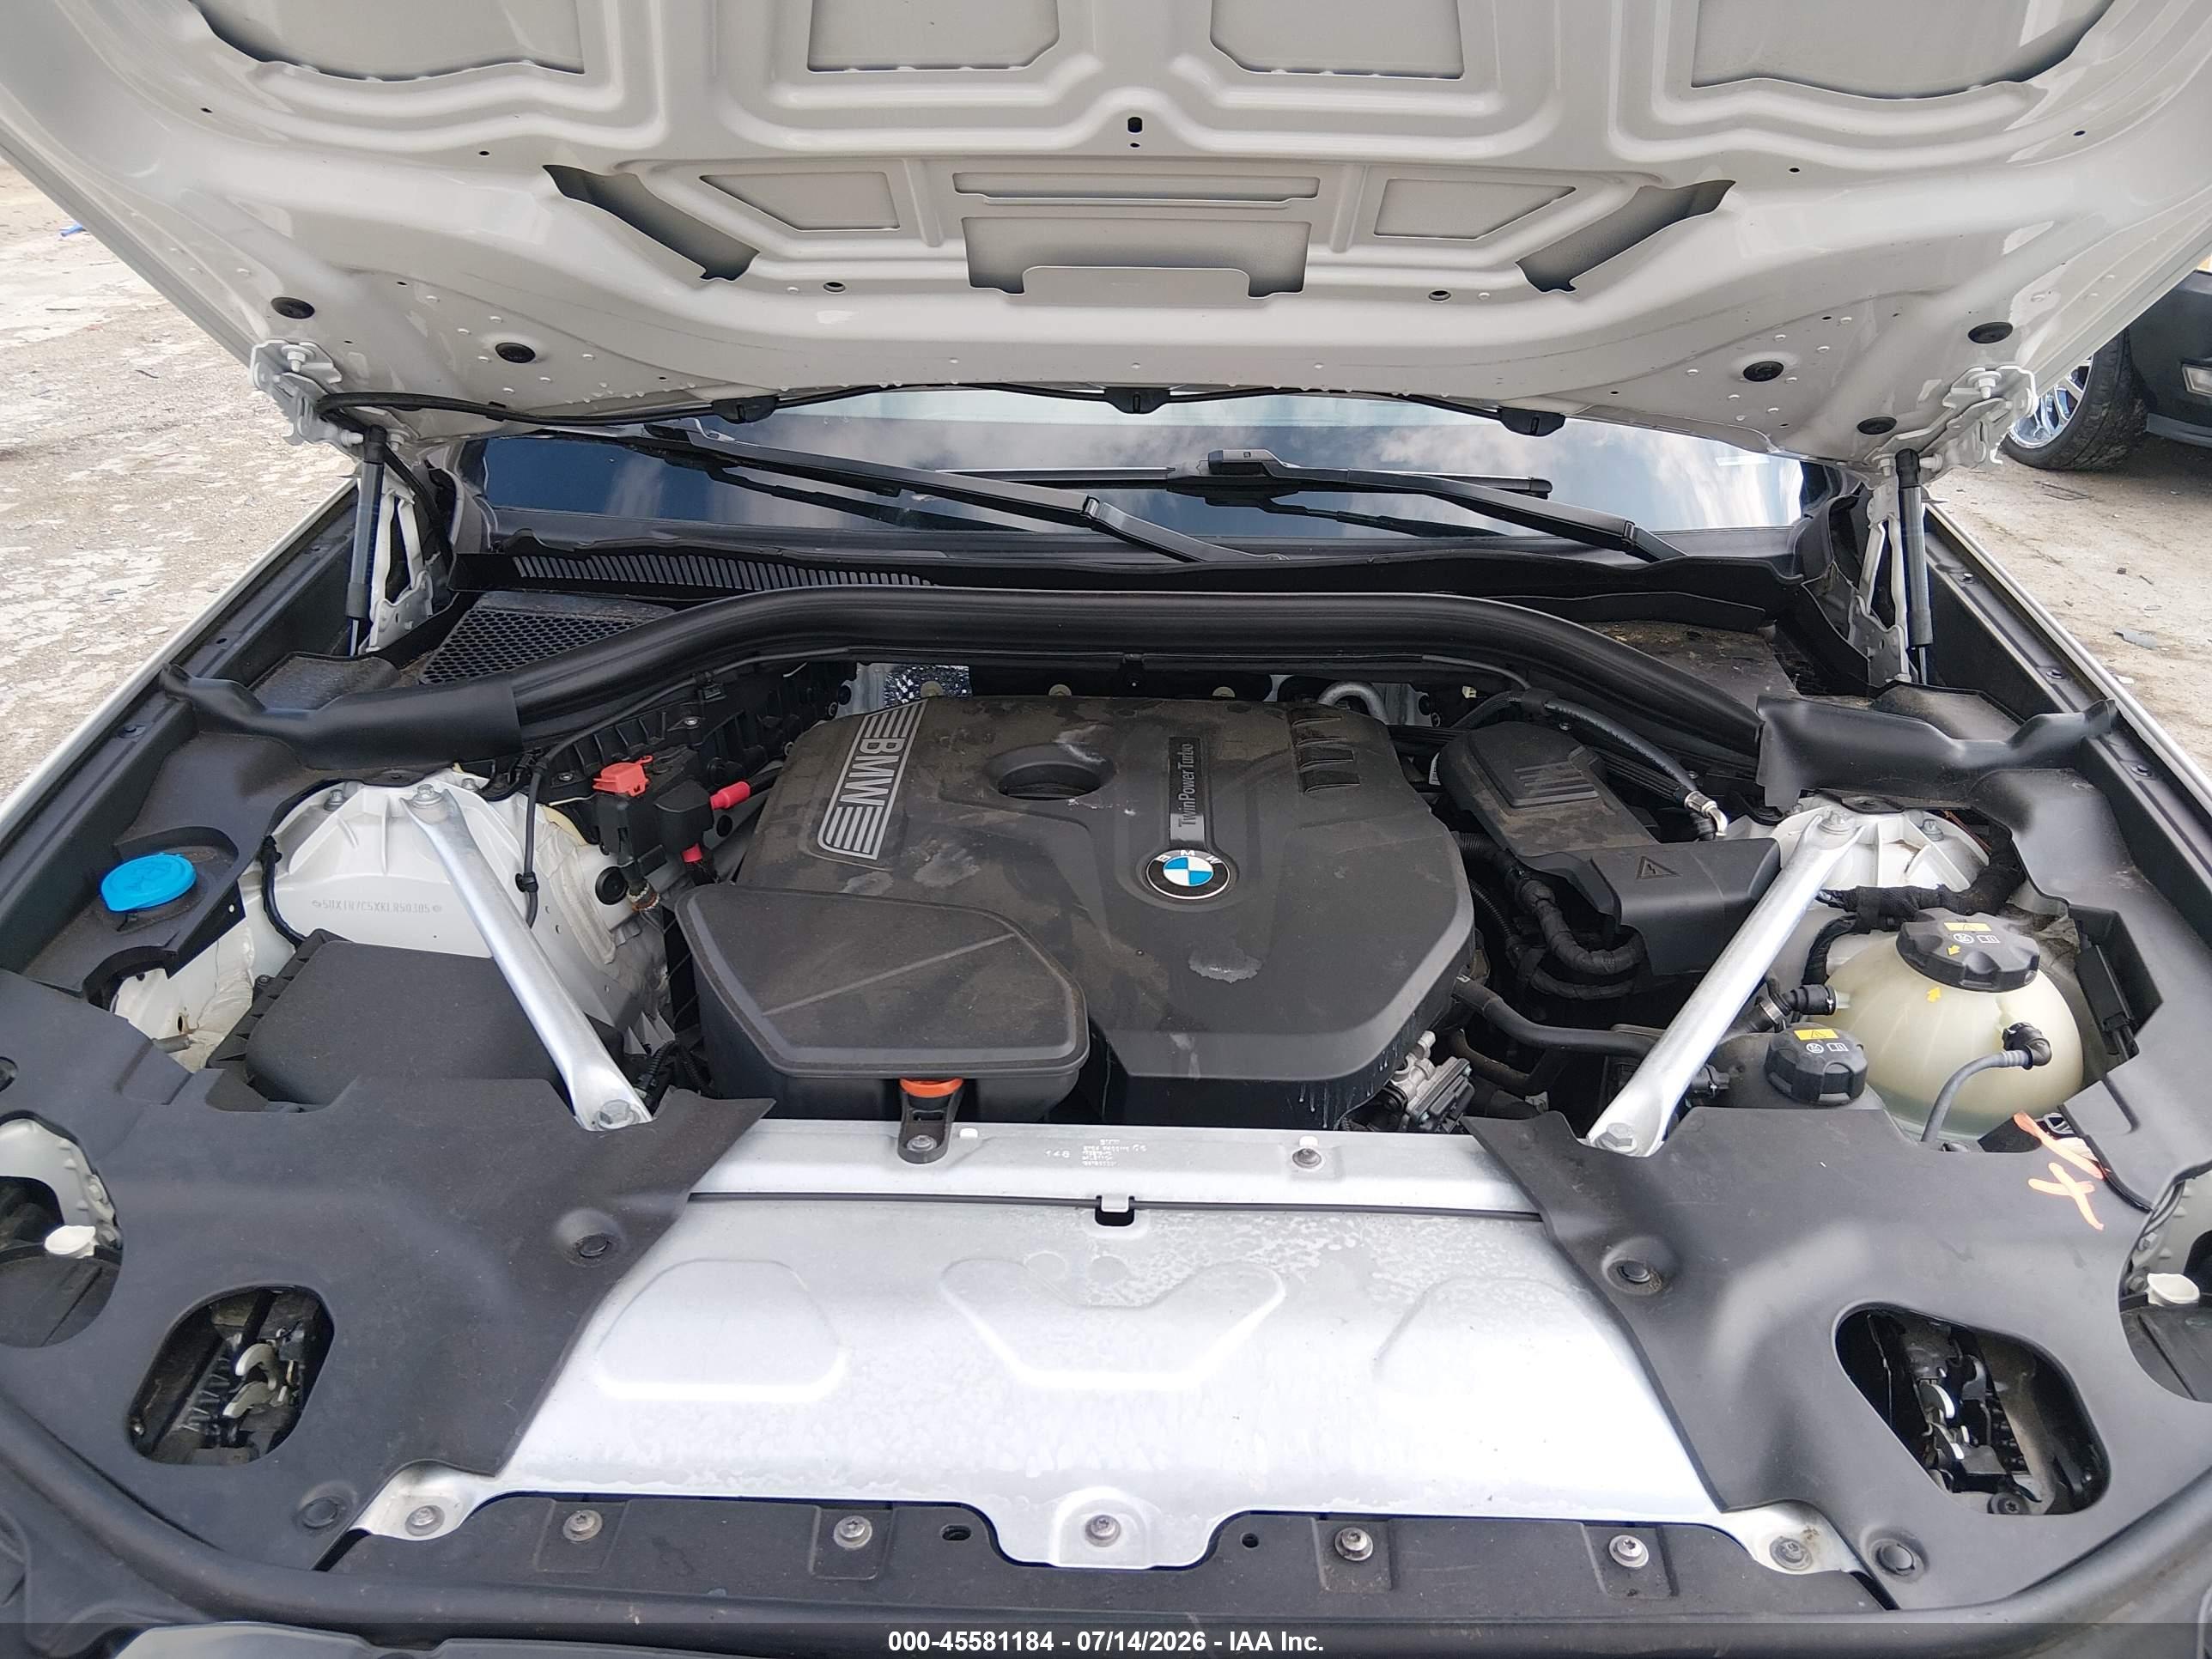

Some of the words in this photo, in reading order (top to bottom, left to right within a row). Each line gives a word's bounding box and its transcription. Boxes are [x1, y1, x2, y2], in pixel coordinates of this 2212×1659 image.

[838, 737, 906, 806] BMW
[1176, 744, 1194, 769] Turbo
[1177, 769, 1196, 828] TwinPower
[1154, 849, 1223, 864] BMW
